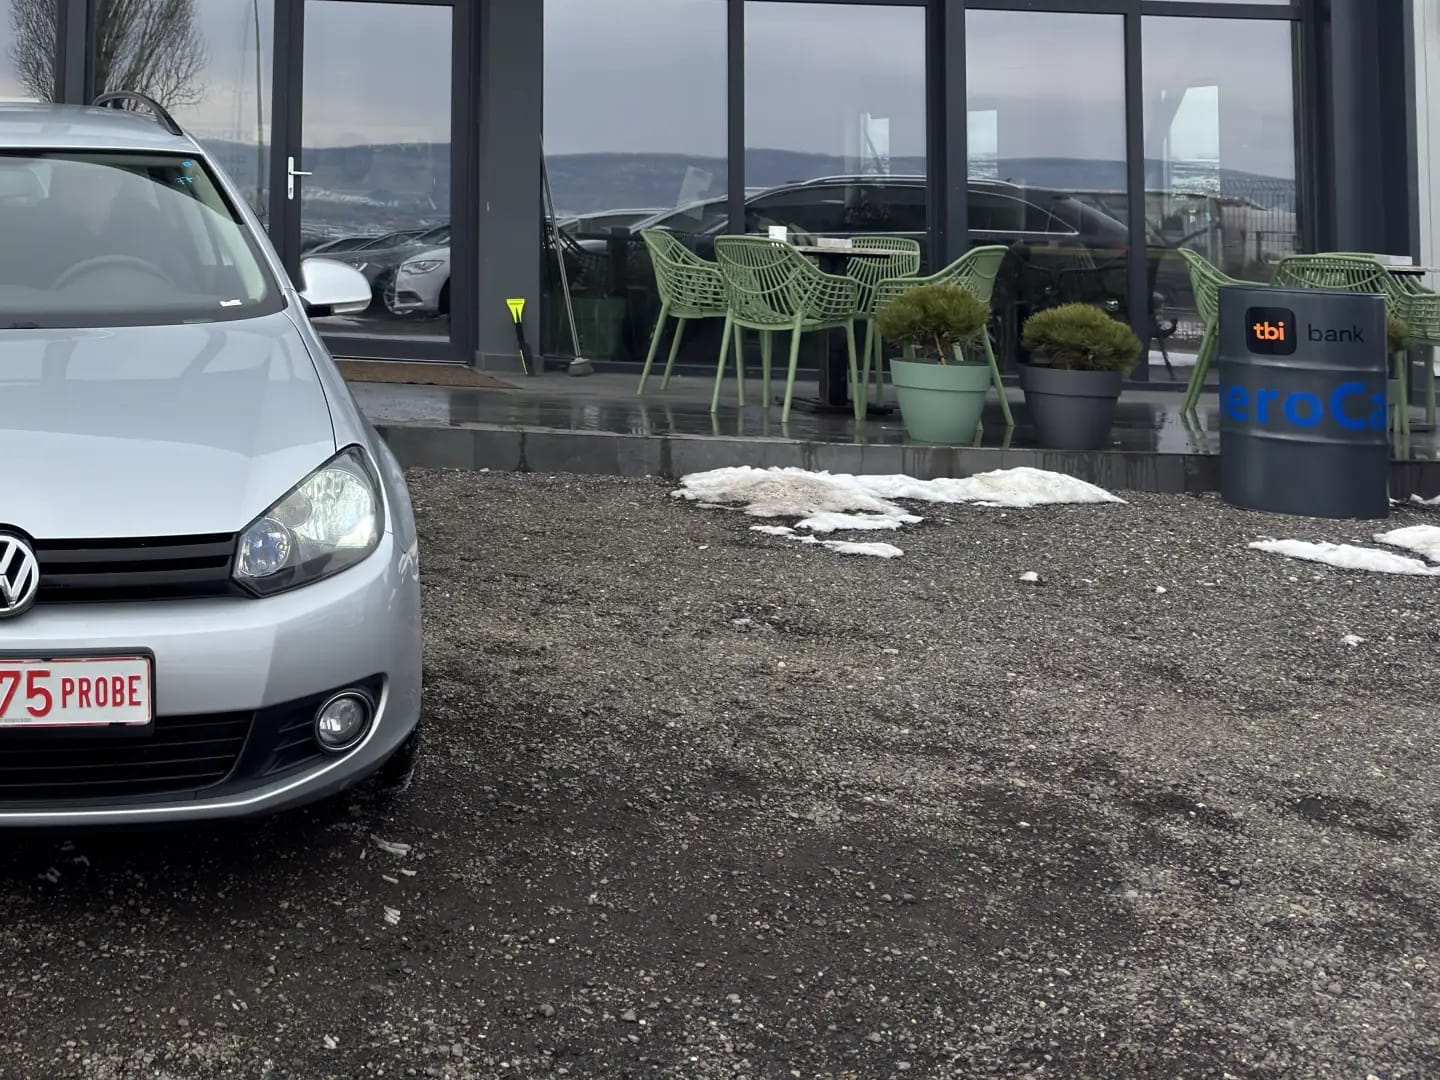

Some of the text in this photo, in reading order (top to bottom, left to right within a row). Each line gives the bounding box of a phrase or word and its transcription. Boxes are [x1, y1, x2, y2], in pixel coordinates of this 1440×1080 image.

[1253, 321, 1364, 342] tbi bank
[1220, 381, 1387, 431] eroCa
[61, 676, 142, 708] PROBE
